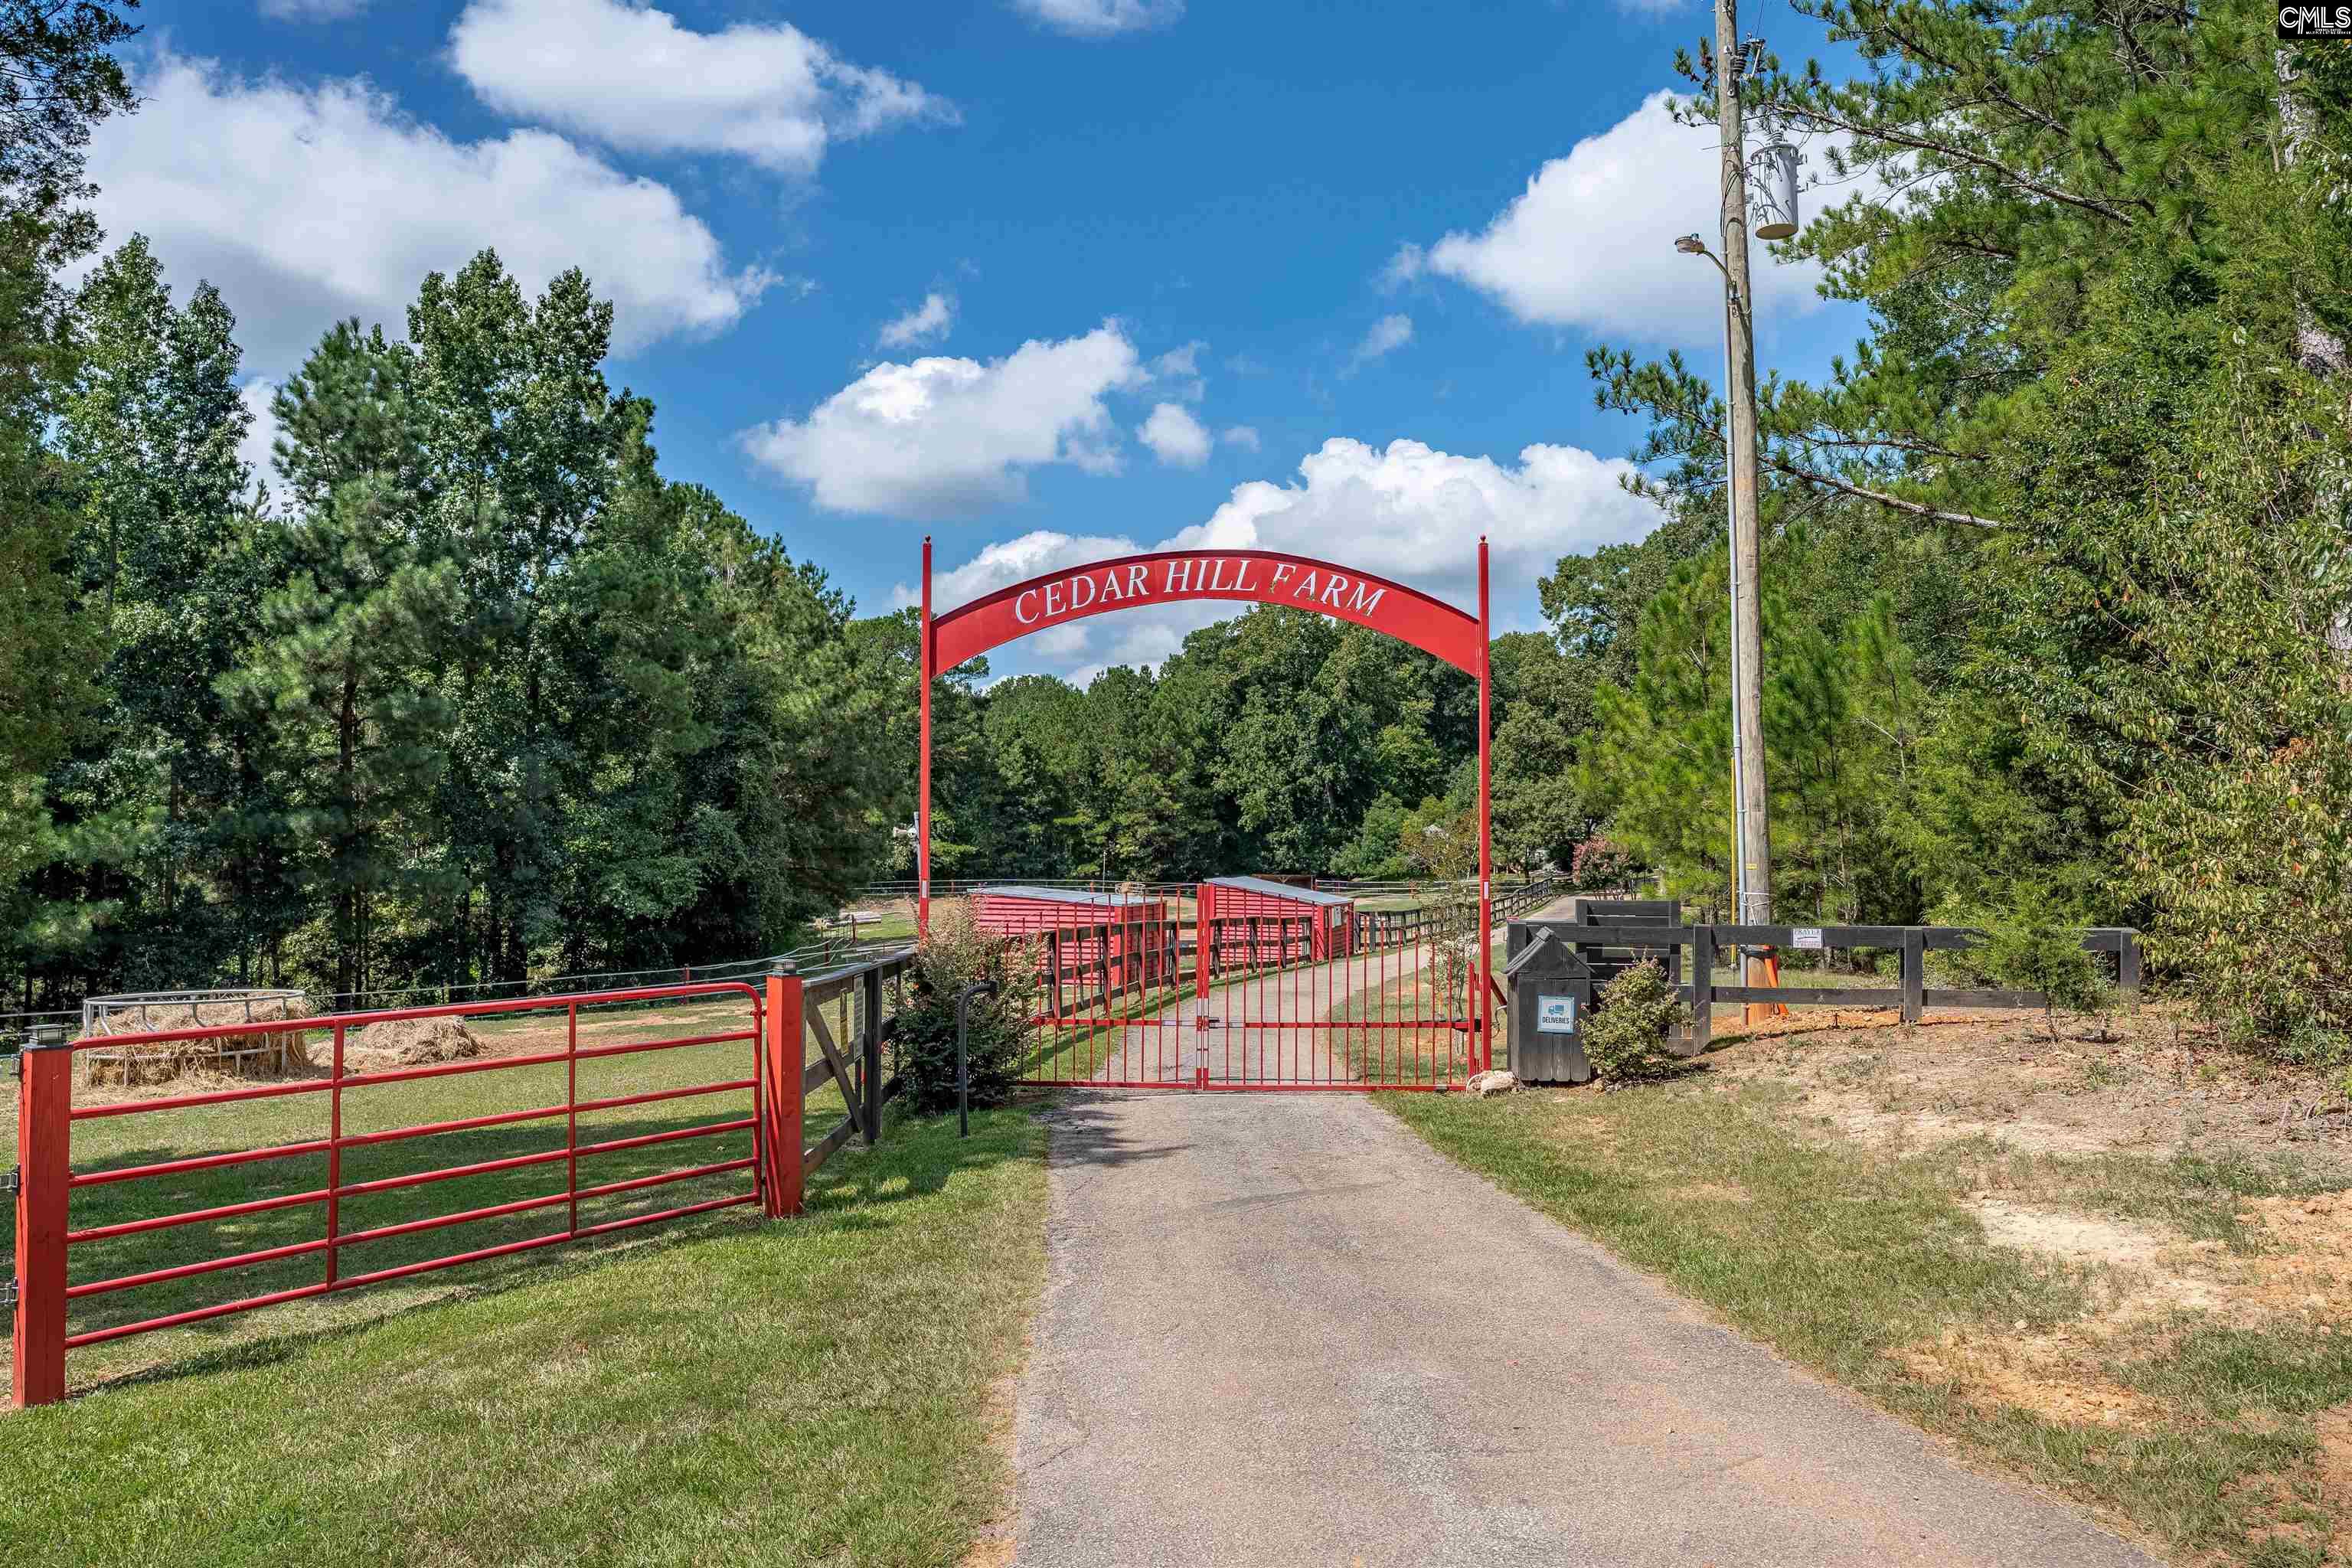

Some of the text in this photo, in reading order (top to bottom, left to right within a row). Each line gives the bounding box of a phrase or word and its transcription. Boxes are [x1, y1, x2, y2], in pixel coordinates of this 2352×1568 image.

[1015, 559, 1387, 624] CEDAR HILL FARM
[1543, 1016, 1570, 1024] DELIVERIES
